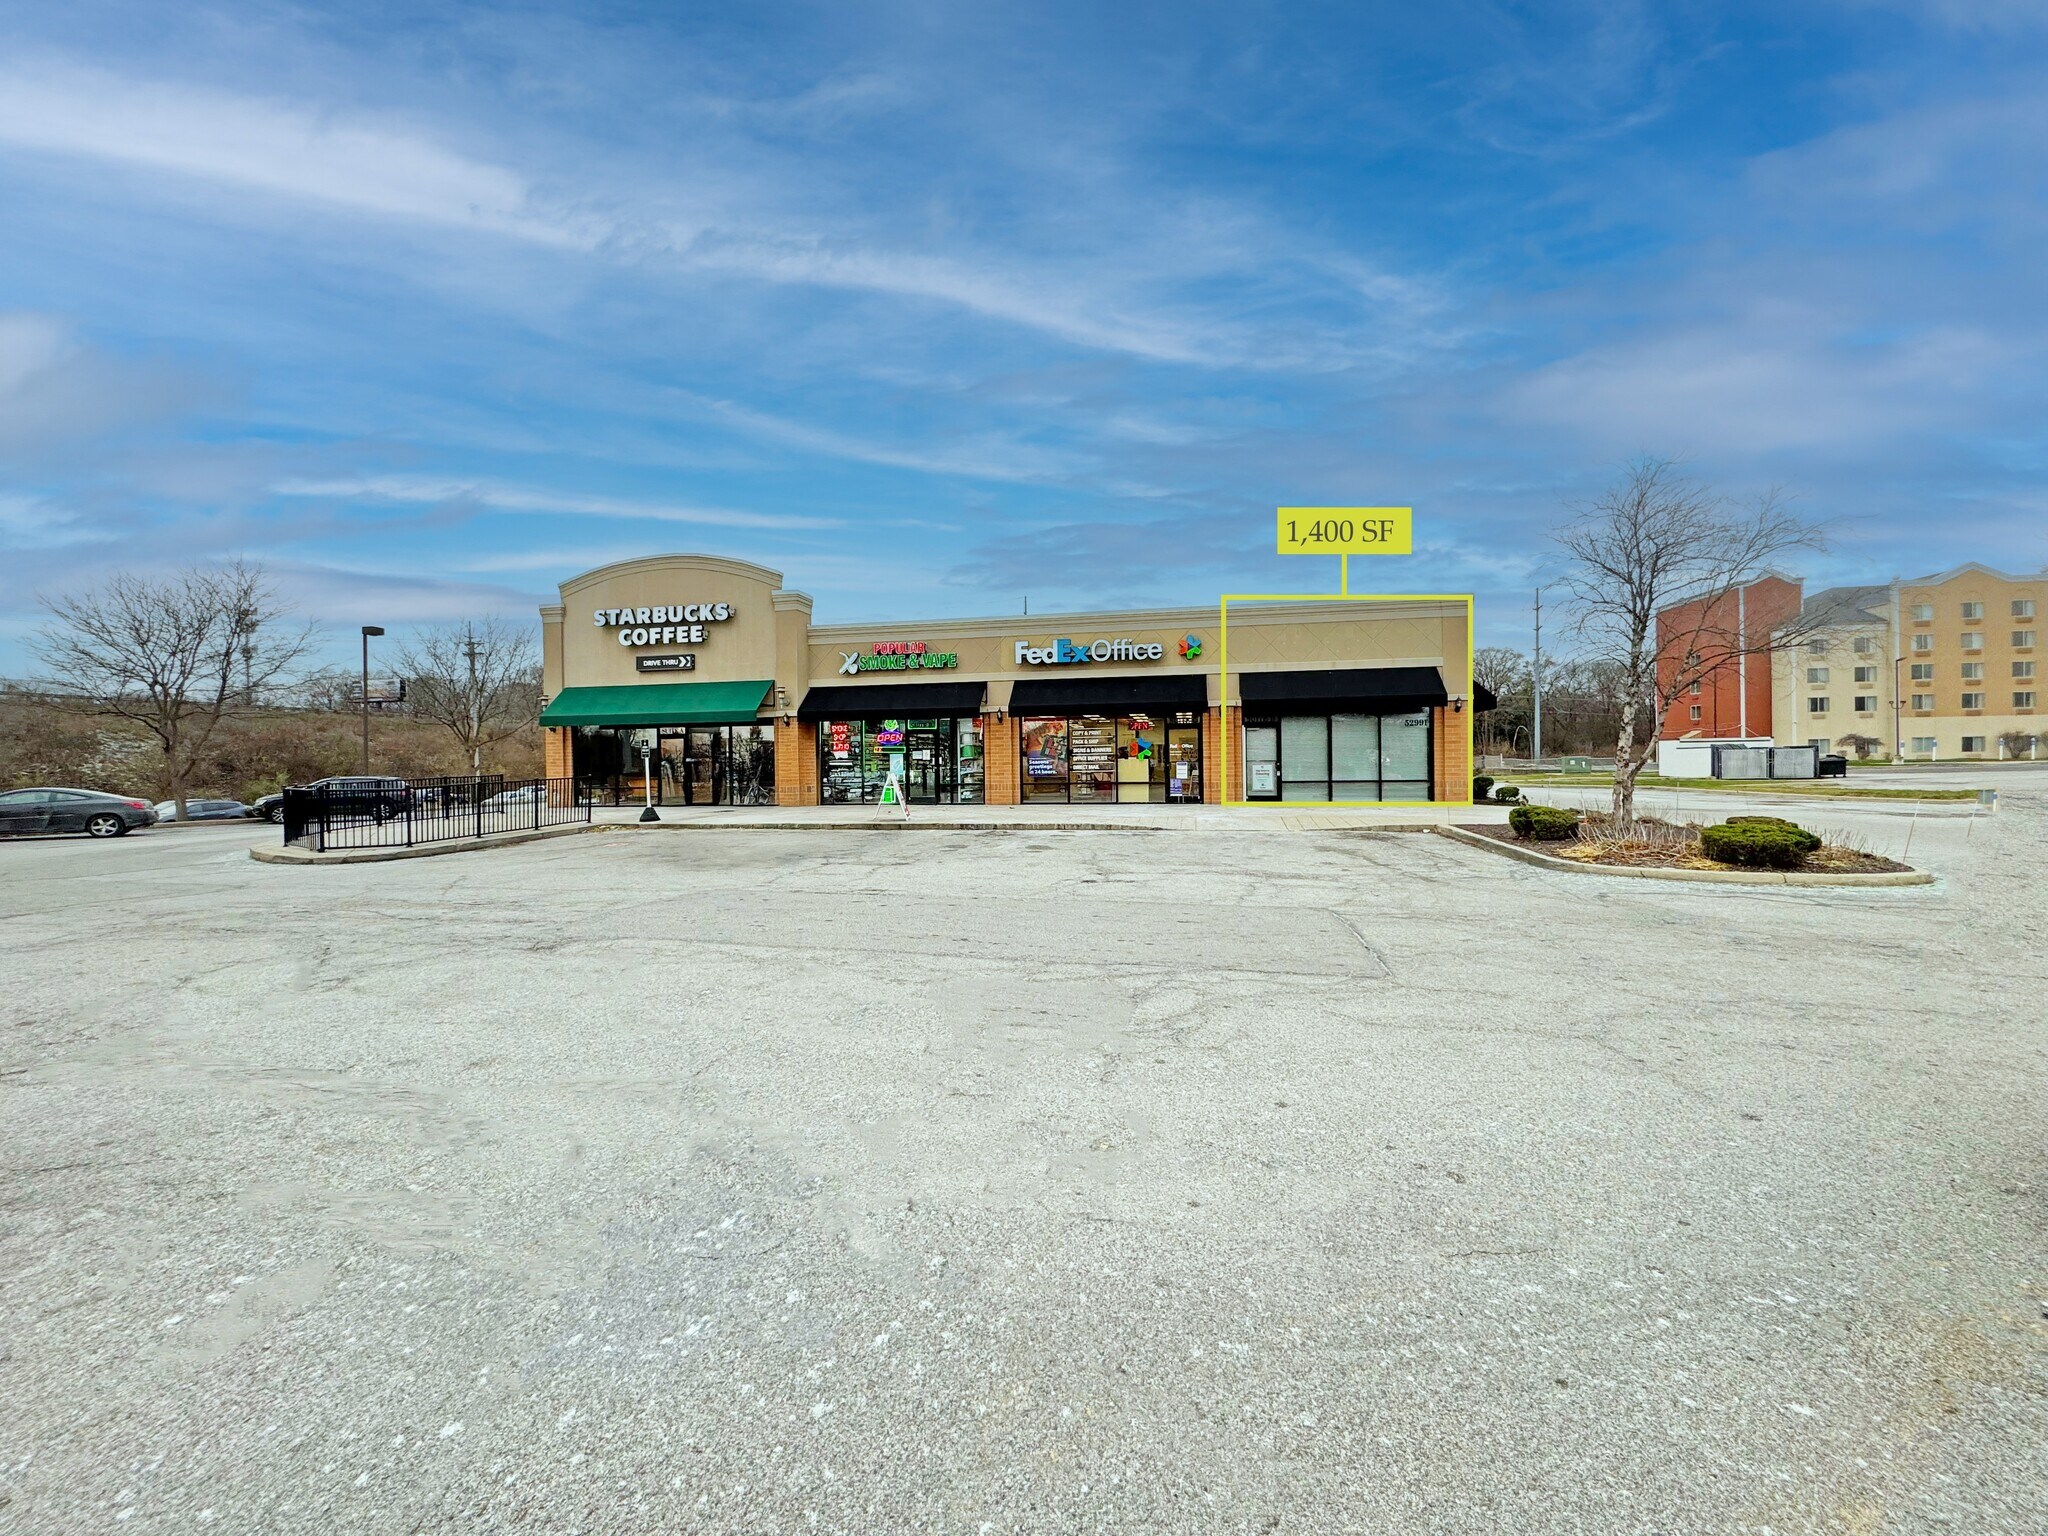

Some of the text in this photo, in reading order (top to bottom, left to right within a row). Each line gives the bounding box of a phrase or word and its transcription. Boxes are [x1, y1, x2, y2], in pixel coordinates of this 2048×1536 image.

[593, 602, 730, 627] STARBUCKS
[618, 625, 704, 647] COFFEE
[873, 641, 927, 655] POPULAR
[1015, 638, 1163, 665] FedEx Office
[859, 652, 959, 671] SMOKE & VAPE
[876, 733, 904, 742] OPEN
